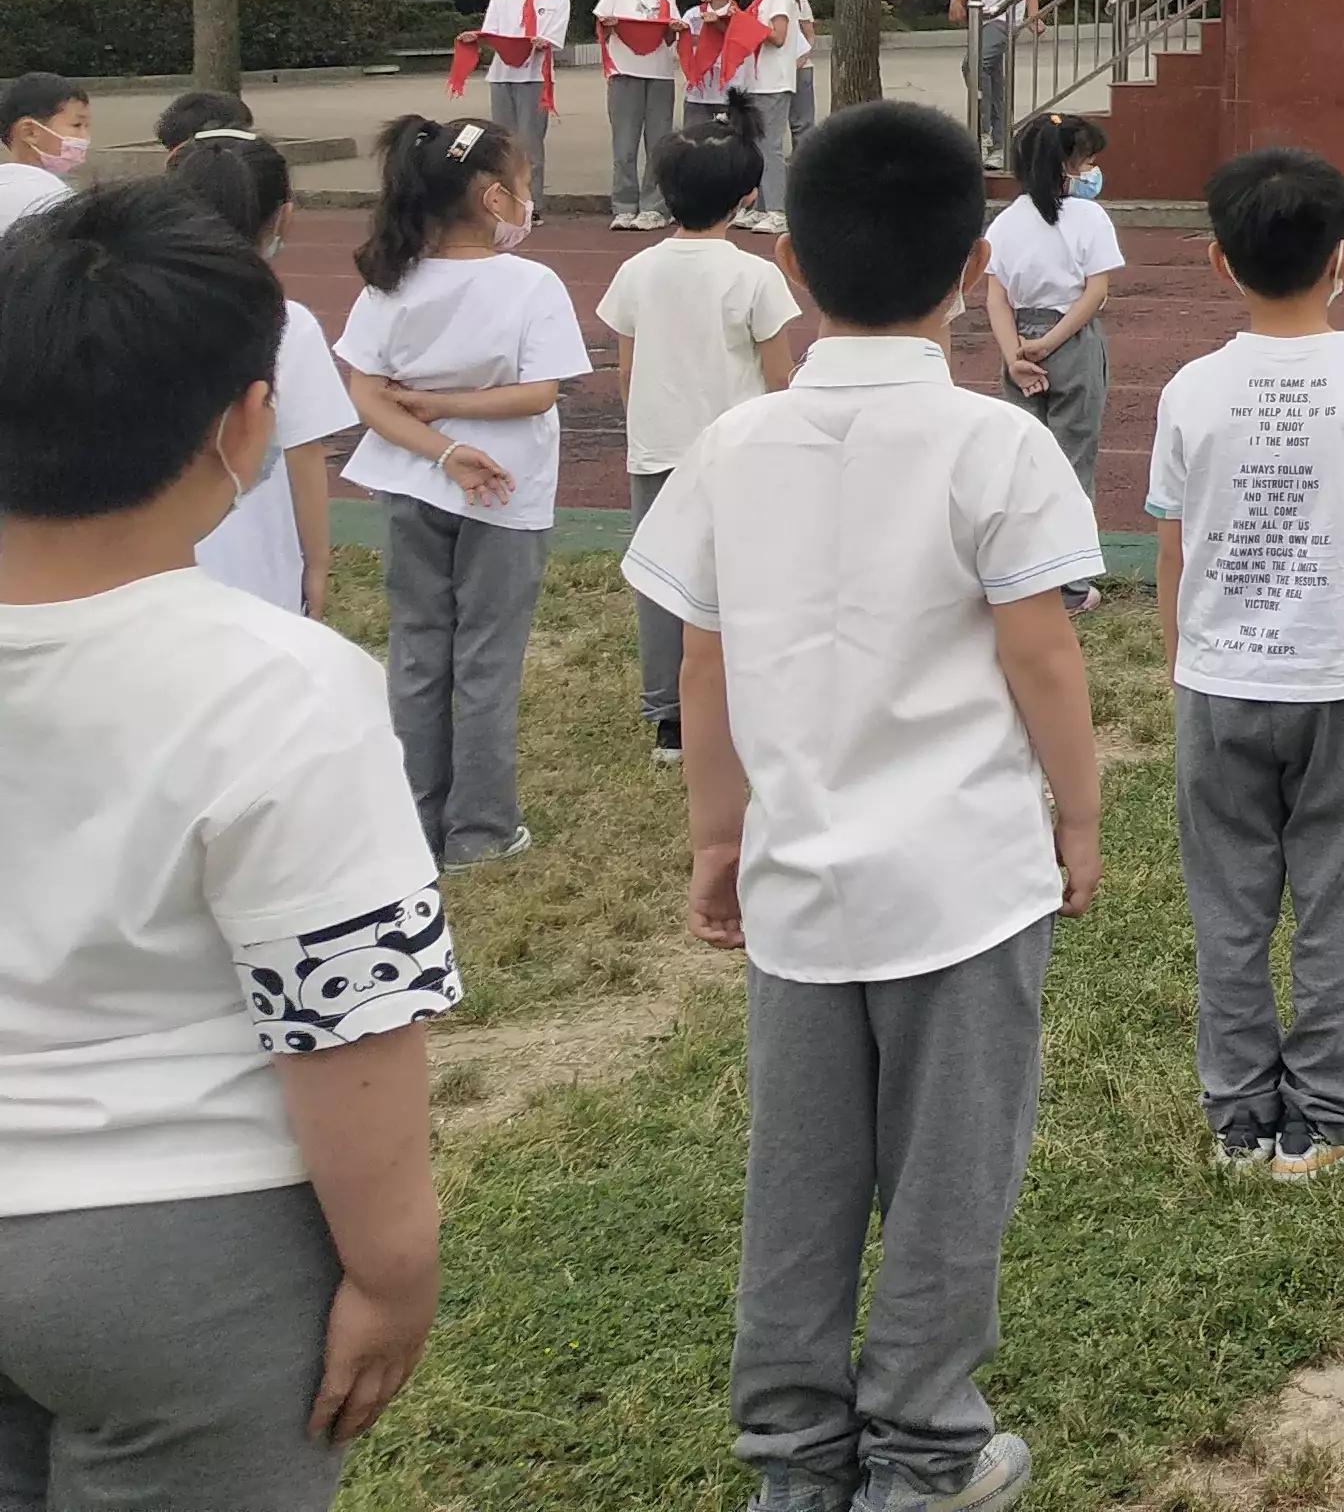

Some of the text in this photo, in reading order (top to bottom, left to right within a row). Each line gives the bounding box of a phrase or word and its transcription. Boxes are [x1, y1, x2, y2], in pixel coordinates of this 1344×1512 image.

[1248, 377, 1328, 388] EVERY GAME HAS
[1230, 406, 1336, 417] THEY HELP ALL OF US
[1260, 421, 1304, 432] TO ENJOY
[1266, 436, 1281, 446] THE
[1286, 437, 1310, 447] MOST
[1240, 464, 1313, 475] ALWAYS FOLLOW
[1232, 478, 1248, 488] THE
[1243, 492, 1304, 503] AND THE FUN
[1248, 506, 1298, 516] WILL COME
[1232, 519, 1310, 531] WHEN ALL OF US
[1207, 532, 1224, 542] ARE
[1228, 533, 1260, 544] PLAYING
[1265, 533, 1283, 544] OUR
[1289, 534, 1307, 545] OWN
[1230, 547, 1308, 558] ALWAYS FOCUS ON
[1272, 560, 1286, 570] THE
[1291, 562, 1318, 573] LIMITS
[1221, 573, 1271, 584] IMPROVING
[1276, 574, 1291, 585] THE
[1267, 586, 1281, 597] THE
[1285, 588, 1303, 599] REAL
[1240, 625, 1280, 639] THIS TIME
[1215, 638, 1220, 648] I
[1223, 639, 1245, 650] PLAY
[1247, 643, 1263, 653] FOR
